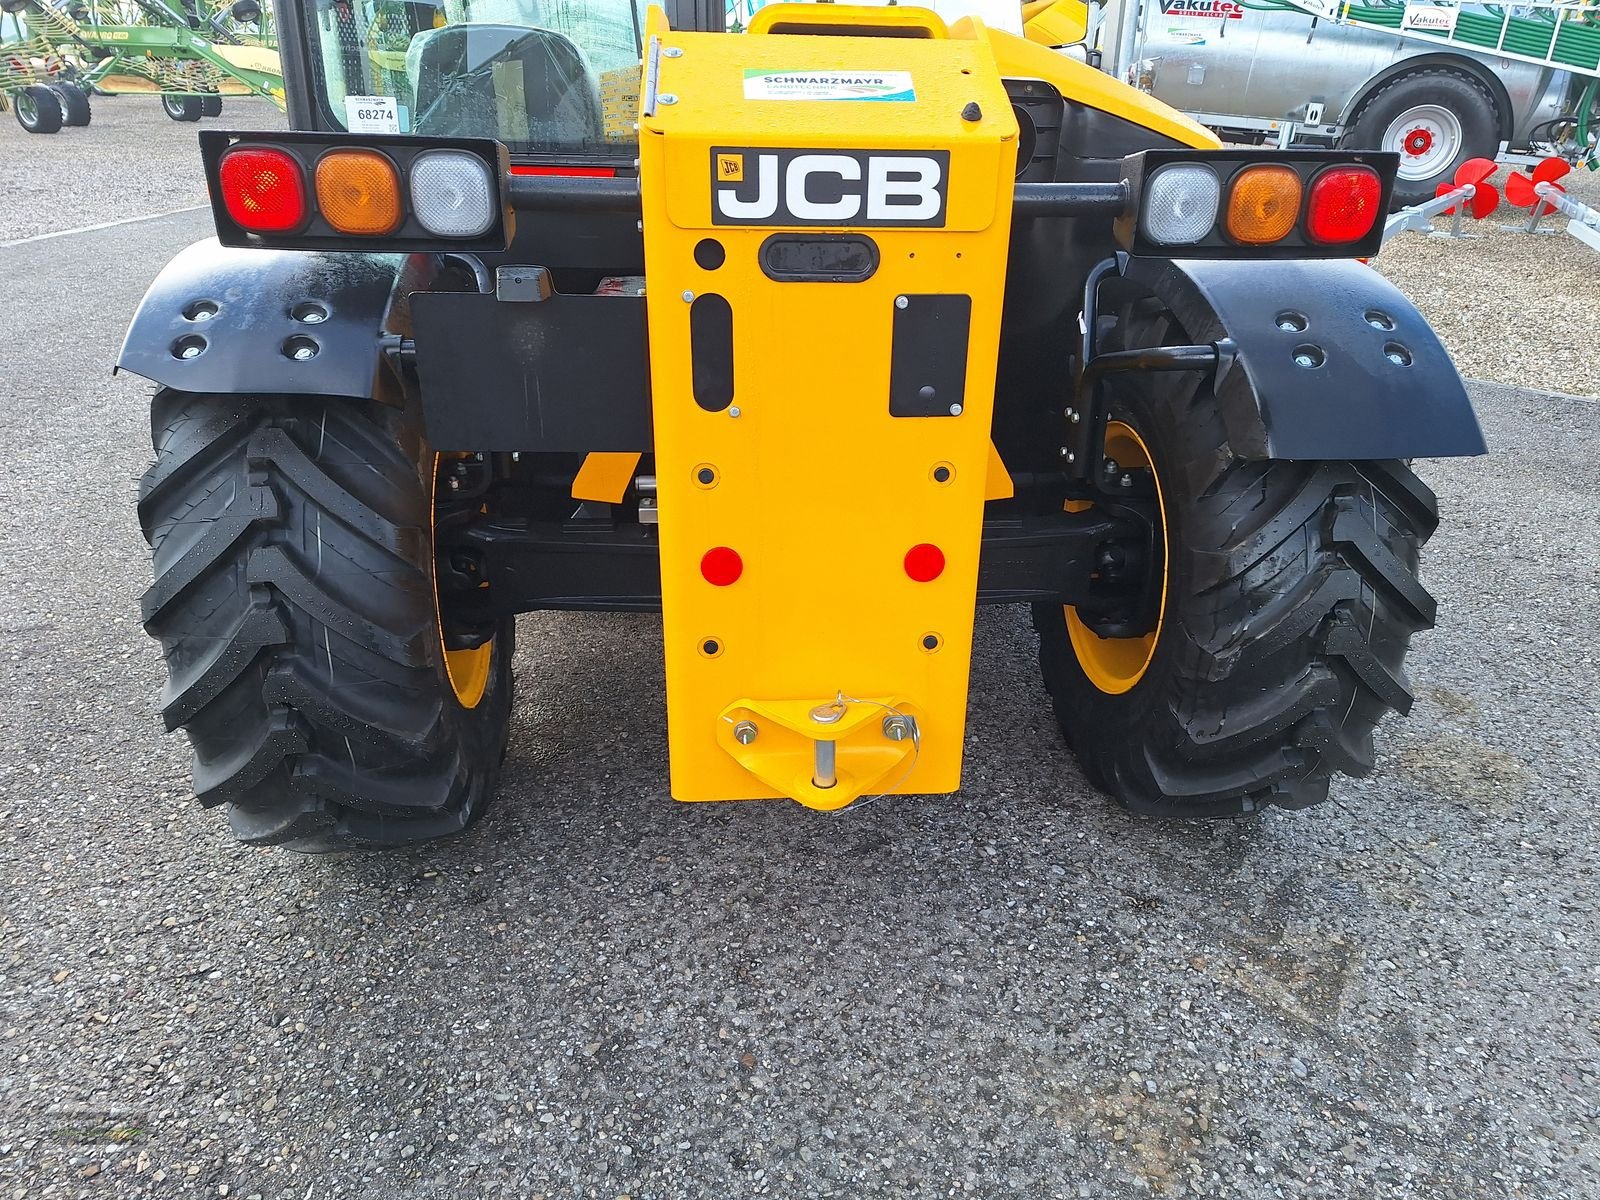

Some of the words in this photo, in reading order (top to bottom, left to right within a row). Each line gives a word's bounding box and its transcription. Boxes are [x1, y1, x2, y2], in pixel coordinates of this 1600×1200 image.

[1159, 0, 1244, 14] Vakutec
[1410, 13, 1450, 25] Vakutec
[763, 76, 884, 85] SCHWARZMAYR
[358, 109, 394, 120] 68274
[724, 161, 739, 174] JCB
[718, 154, 941, 220] JCB
